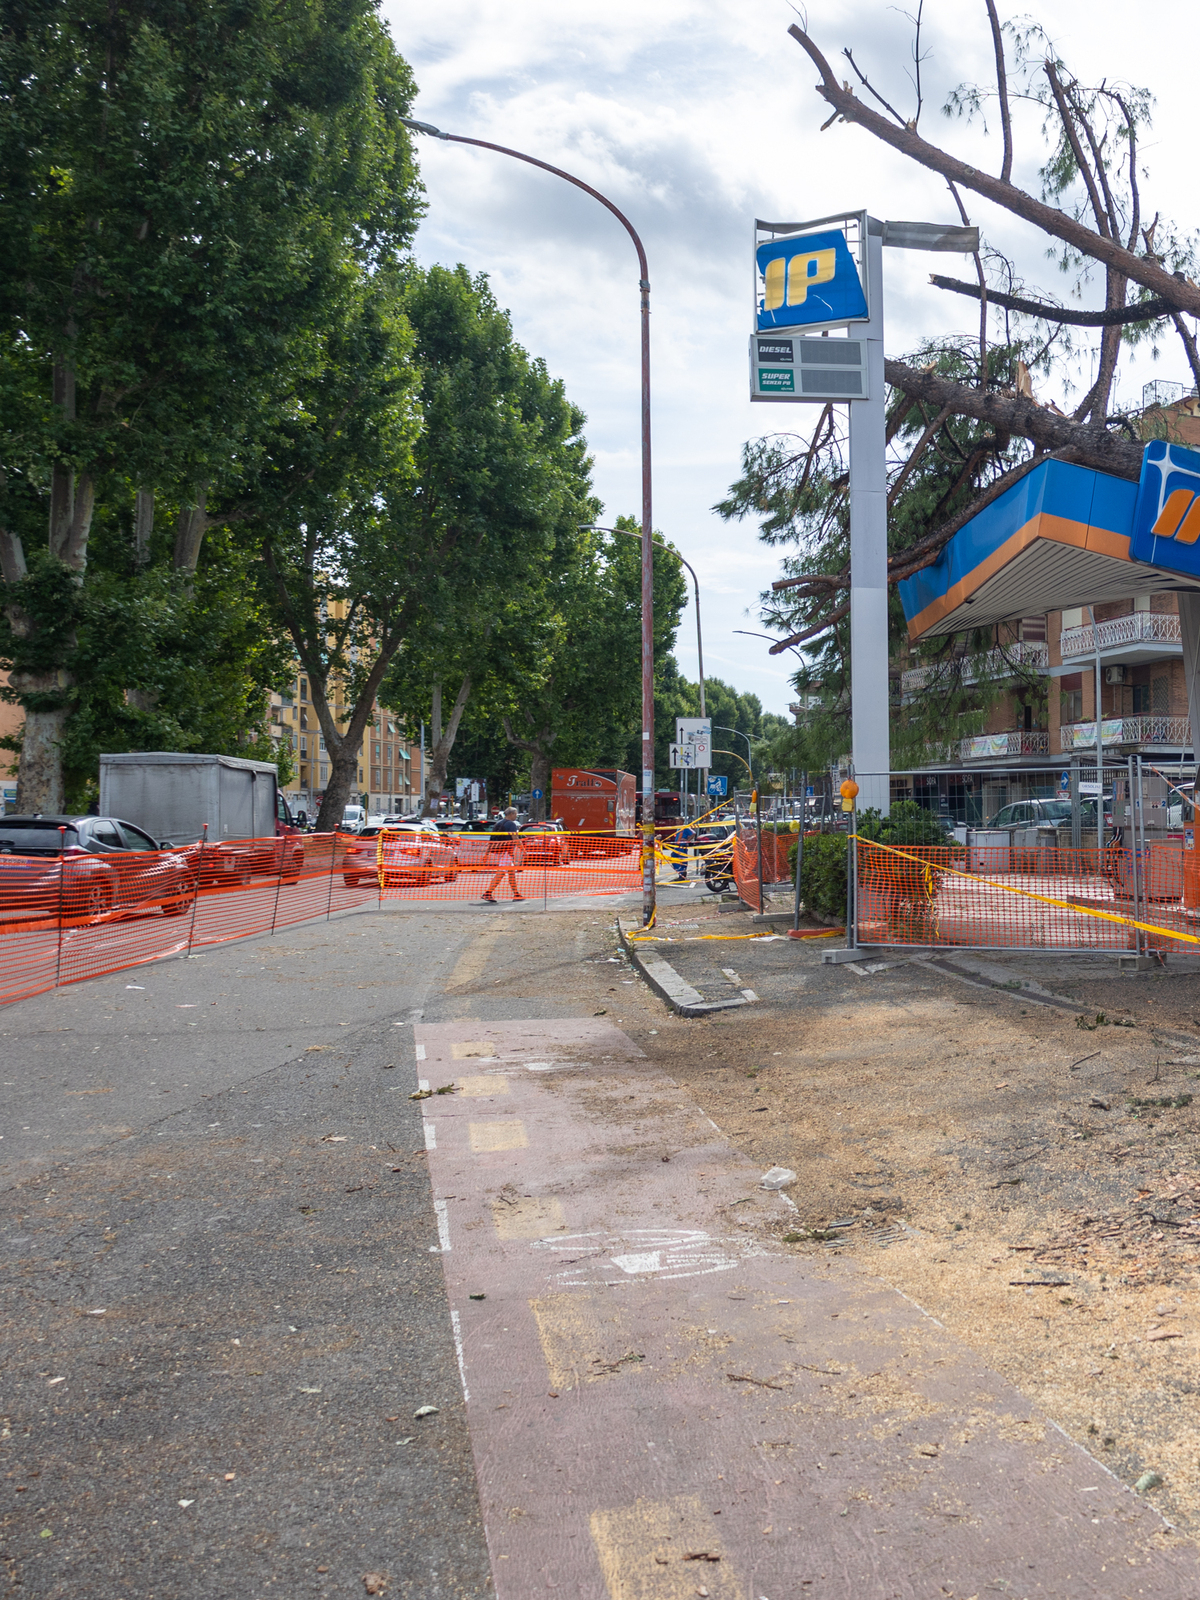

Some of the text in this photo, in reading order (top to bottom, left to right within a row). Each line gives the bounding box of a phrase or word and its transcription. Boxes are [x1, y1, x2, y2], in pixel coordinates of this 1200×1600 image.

[764, 248, 836, 311] IP
[759, 345, 792, 354] DIESEL
[761, 372, 791, 380] SUPER
